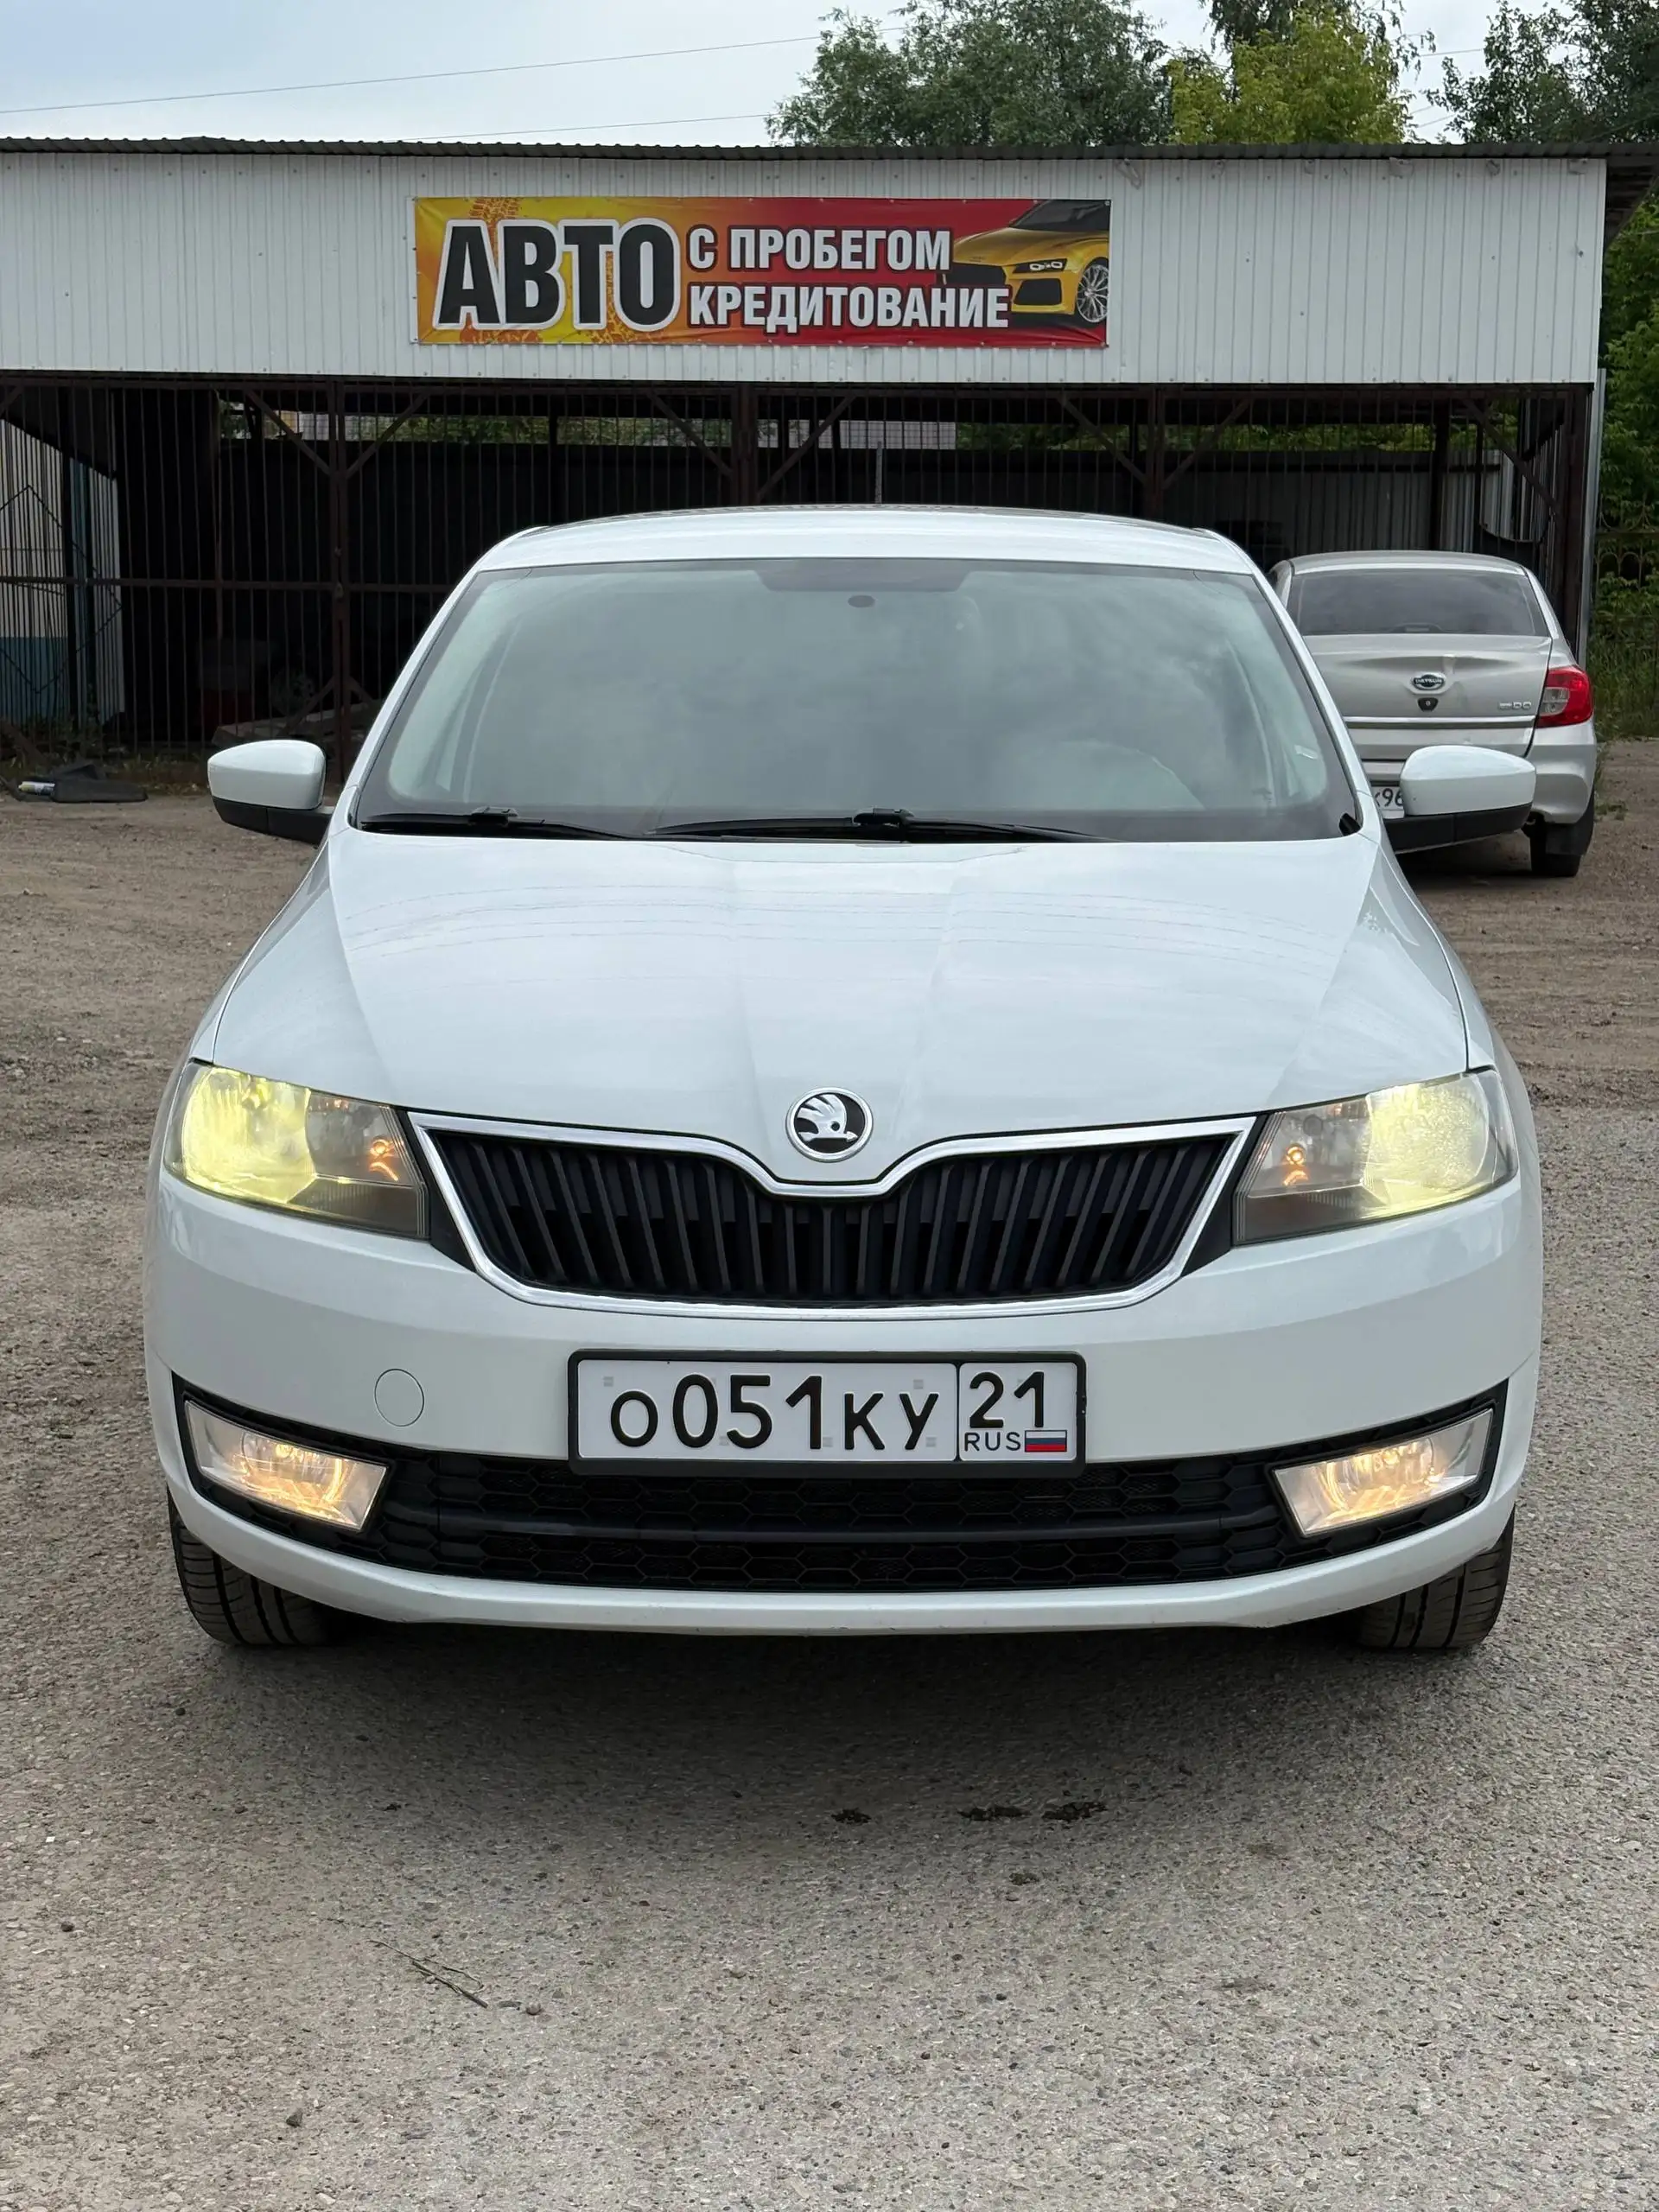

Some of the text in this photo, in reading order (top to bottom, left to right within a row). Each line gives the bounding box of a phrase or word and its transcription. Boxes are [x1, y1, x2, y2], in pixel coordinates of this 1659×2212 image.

[690, 228, 950, 270] С ПРОБЕГОМ
[436, 222, 677, 328] АВТО
[690, 285, 1009, 334] КРЕДИТОВАНИЕ
[969, 1371, 1045, 1429] 21
[963, 1431, 1021, 1452] RUS
